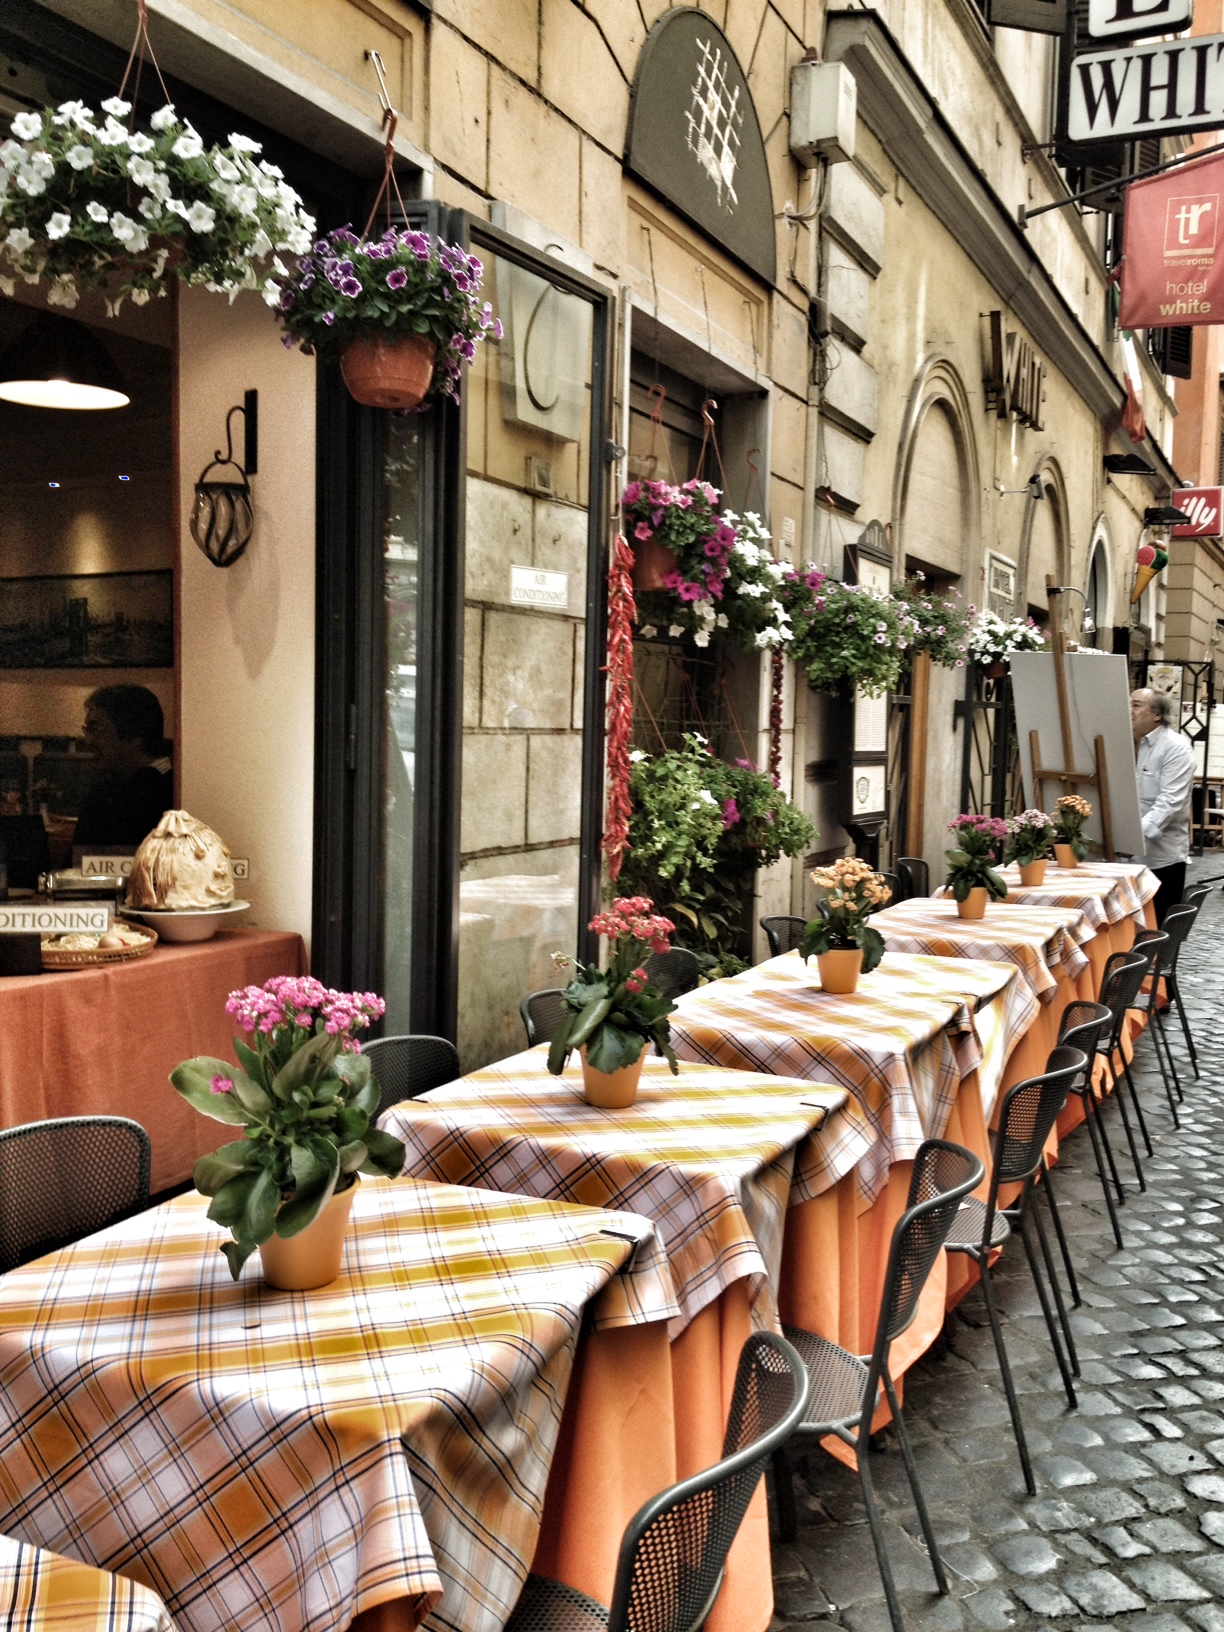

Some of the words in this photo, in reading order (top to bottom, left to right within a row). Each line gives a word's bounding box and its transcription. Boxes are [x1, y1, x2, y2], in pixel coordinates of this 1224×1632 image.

[1077, 41, 1224, 130] WHI
[1165, 278, 1208, 296] hotel
[1159, 299, 1212, 316] white
[1176, 497, 1217, 532] illy
[86, 861, 115, 874] AIR
